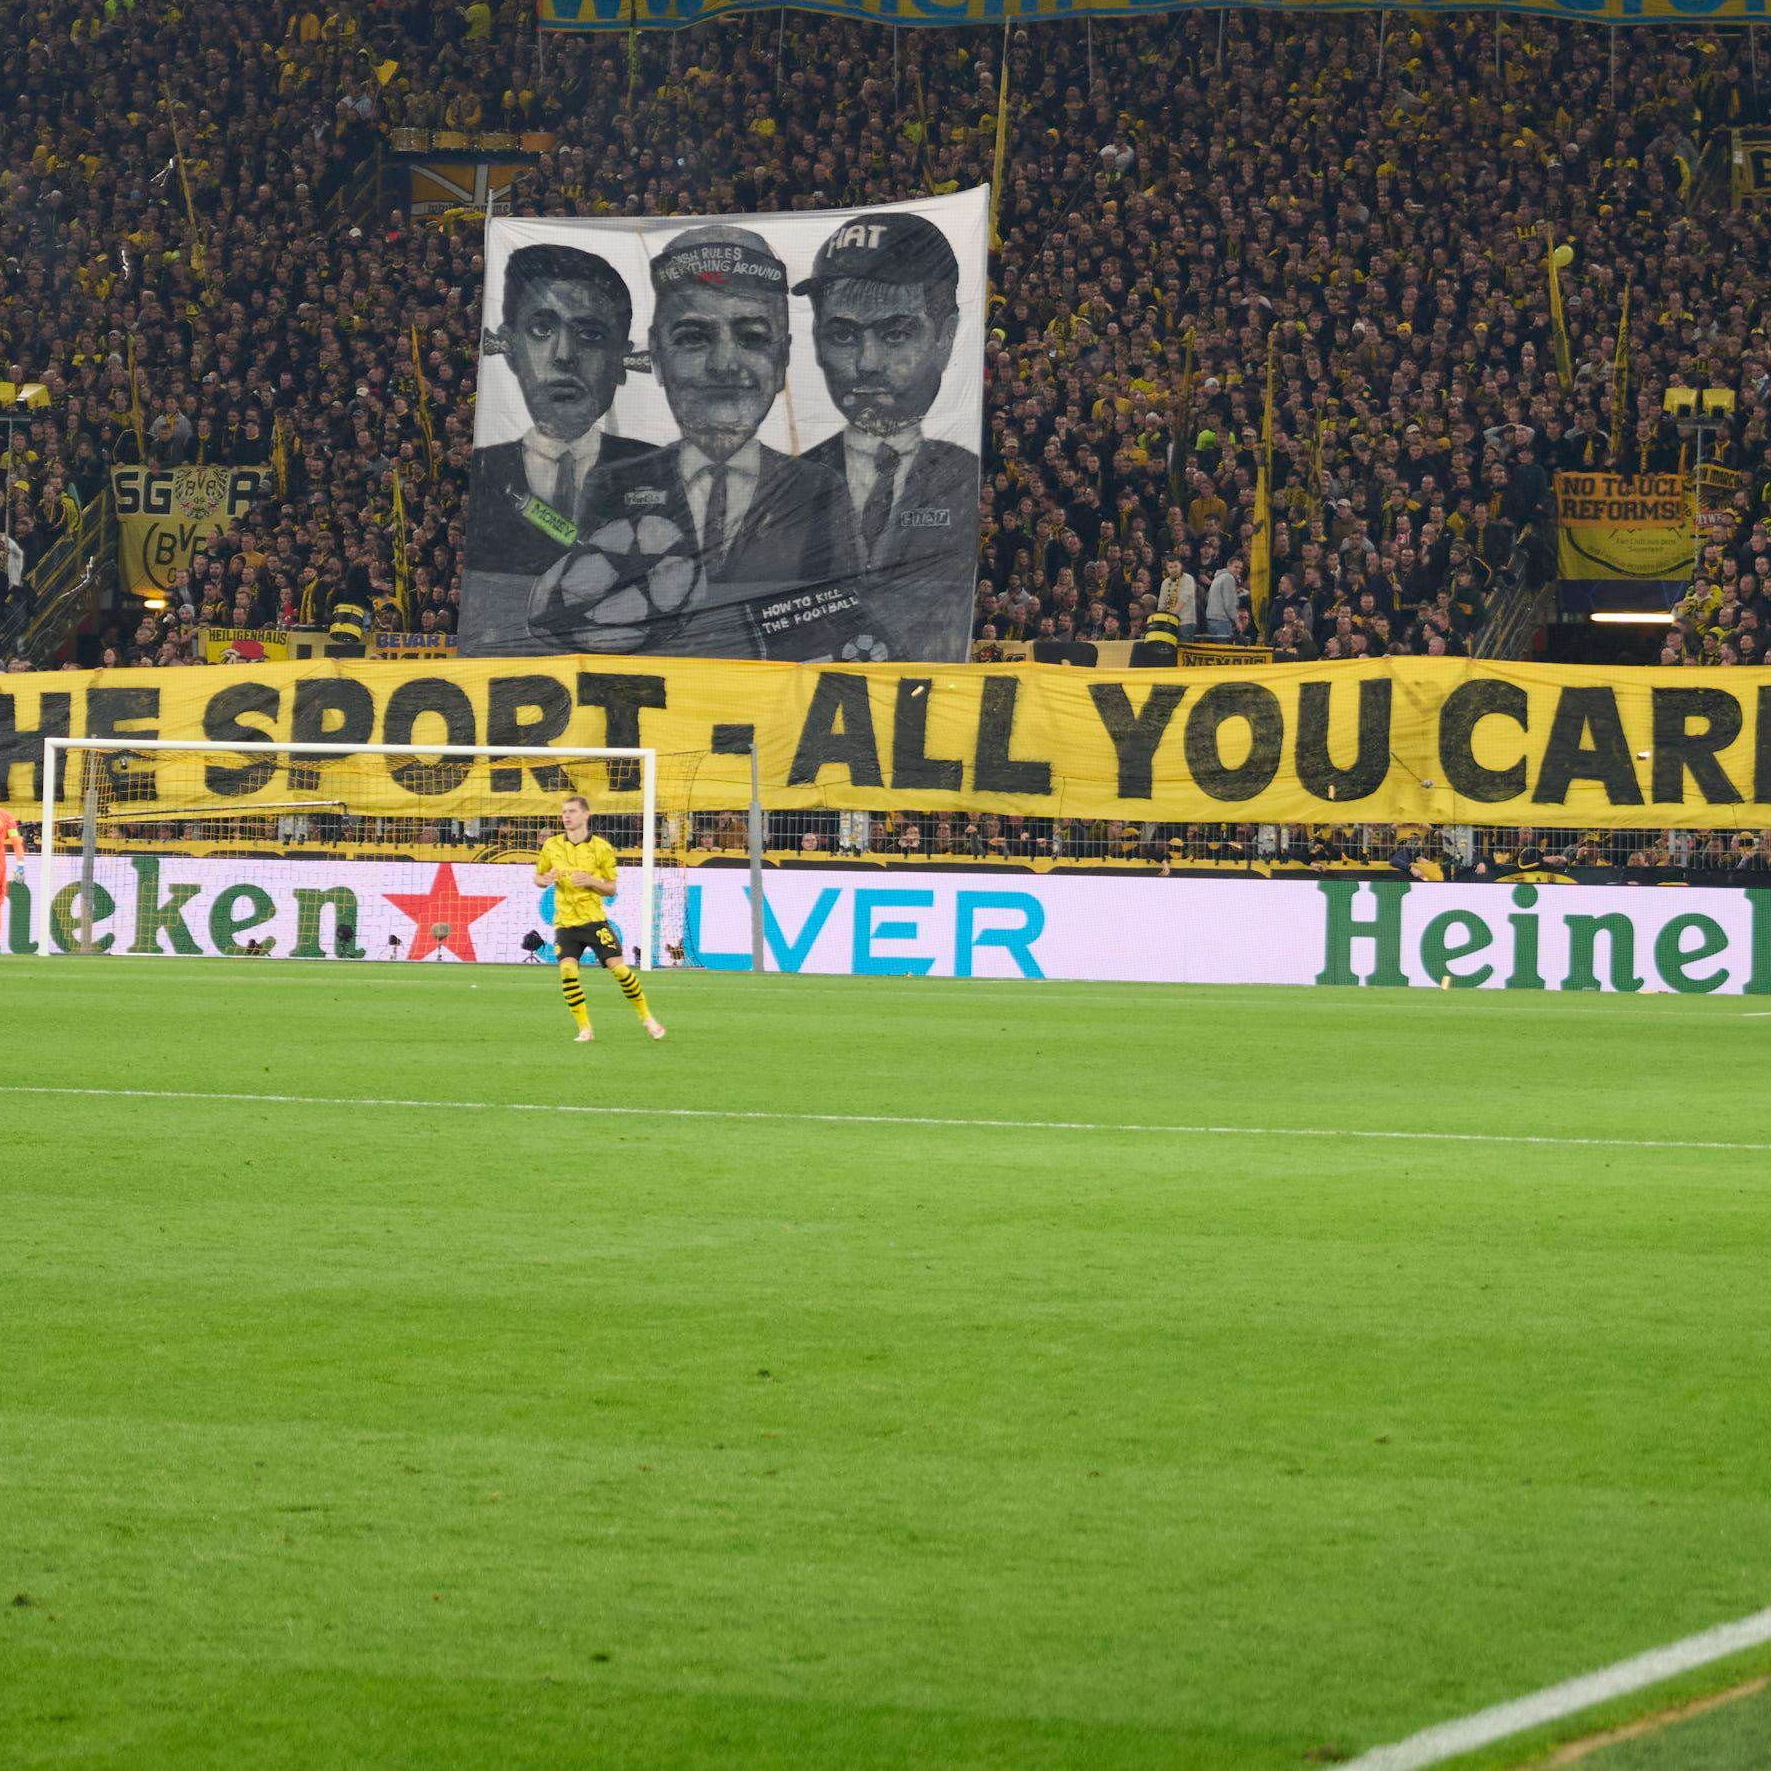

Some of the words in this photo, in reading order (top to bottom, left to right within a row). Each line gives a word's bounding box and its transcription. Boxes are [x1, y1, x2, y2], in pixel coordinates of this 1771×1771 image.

[701, 247, 742, 261] RULES
[732, 261, 781, 281] AROUND
[115, 471, 174, 515] SG
[1563, 478, 1595, 496] NO
[1639, 478, 1681, 497] UCL
[531, 503, 575, 537] MONEY
[1562, 500, 1681, 520] REFORMS!
[761, 617, 789, 634] THE
[794, 596, 859, 625] FOOTBALL
[762, 600, 791, 619] HOW
[792, 595, 812, 608] TO
[815, 588, 843, 604] KILL
[208, 629, 288, 645] HEILIGENHAUS
[203, 672, 668, 796] SPORT
[787, 672, 1053, 795] ALL
[1088, 678, 1392, 803] YOU
